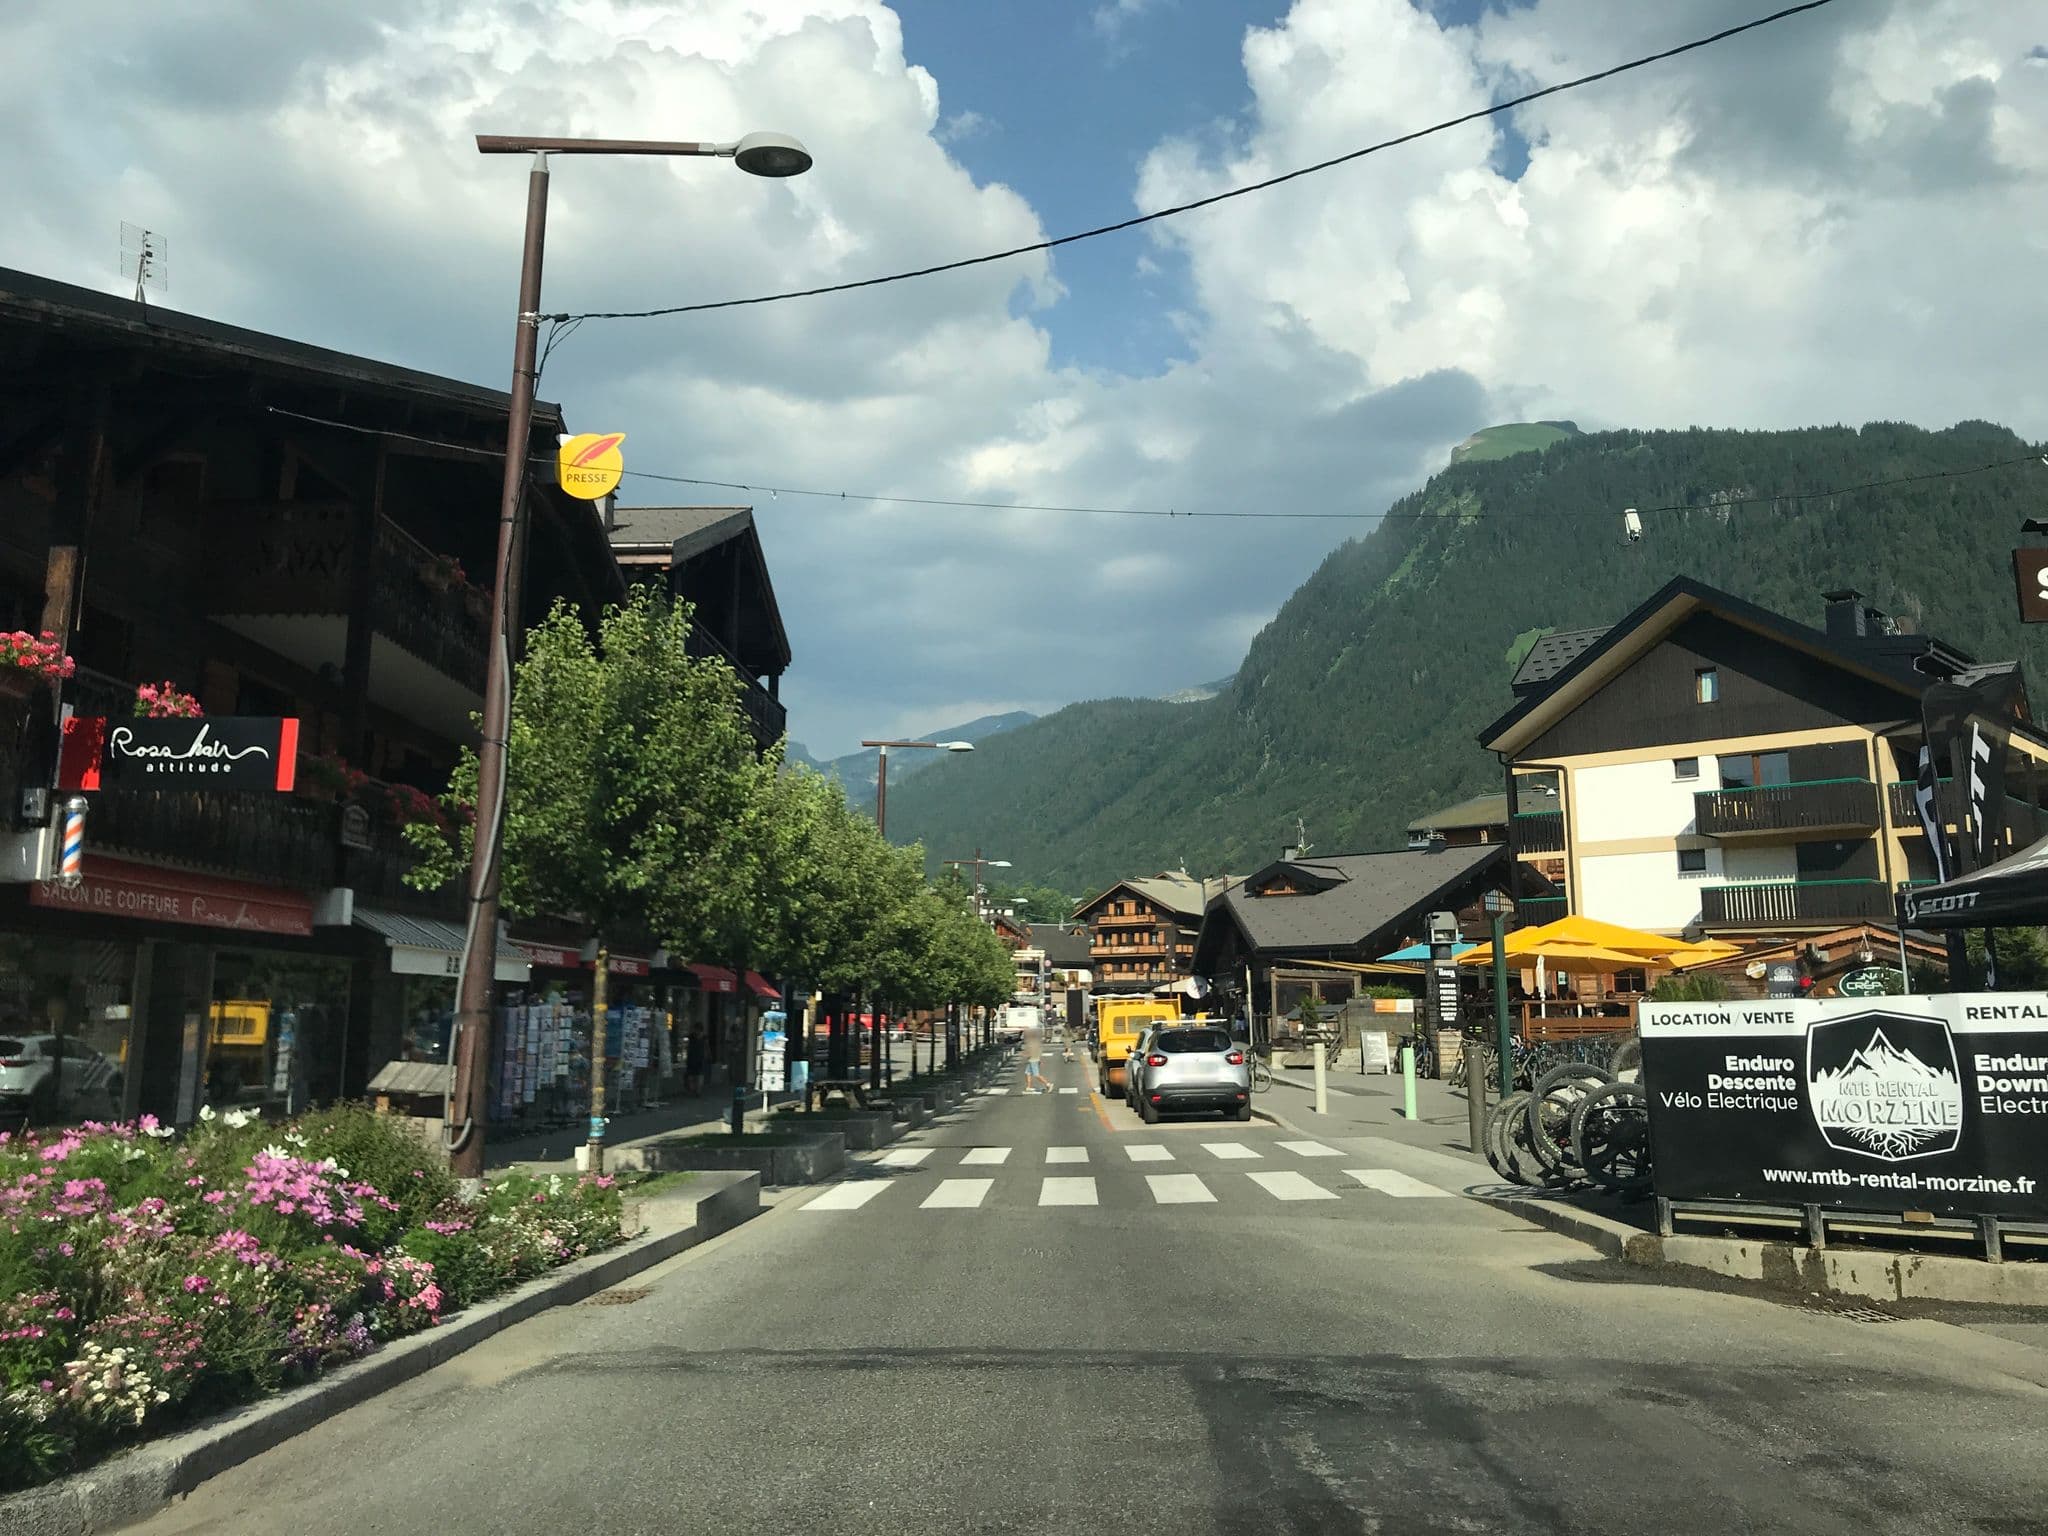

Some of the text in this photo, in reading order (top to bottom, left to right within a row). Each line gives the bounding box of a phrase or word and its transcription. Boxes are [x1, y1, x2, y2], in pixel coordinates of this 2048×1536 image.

[566, 473, 608, 483] PRESSE
[146, 762, 232, 773] attitude
[40, 879, 90, 905] SALON
[94, 887, 113, 907] DE
[116, 890, 180, 916] COIFFURE
[1918, 891, 1981, 915] SCOTT
[1651, 1012, 1731, 1026] LOCATION
[1742, 1011, 1795, 1024] VENTE
[1725, 1055, 1795, 1072] Enduro
[1708, 1074, 1797, 1091] Descente
[1839, 1080, 1939, 1098] MTB RENTAL
[1976, 1075, 2048, 1093] Down
[1660, 1091, 1798, 1112] Vélo Electrique
[1820, 1098, 1960, 1126] MORZINE
[1762, 1168, 2036, 1195] www.mtb-rental-morzine.fr
